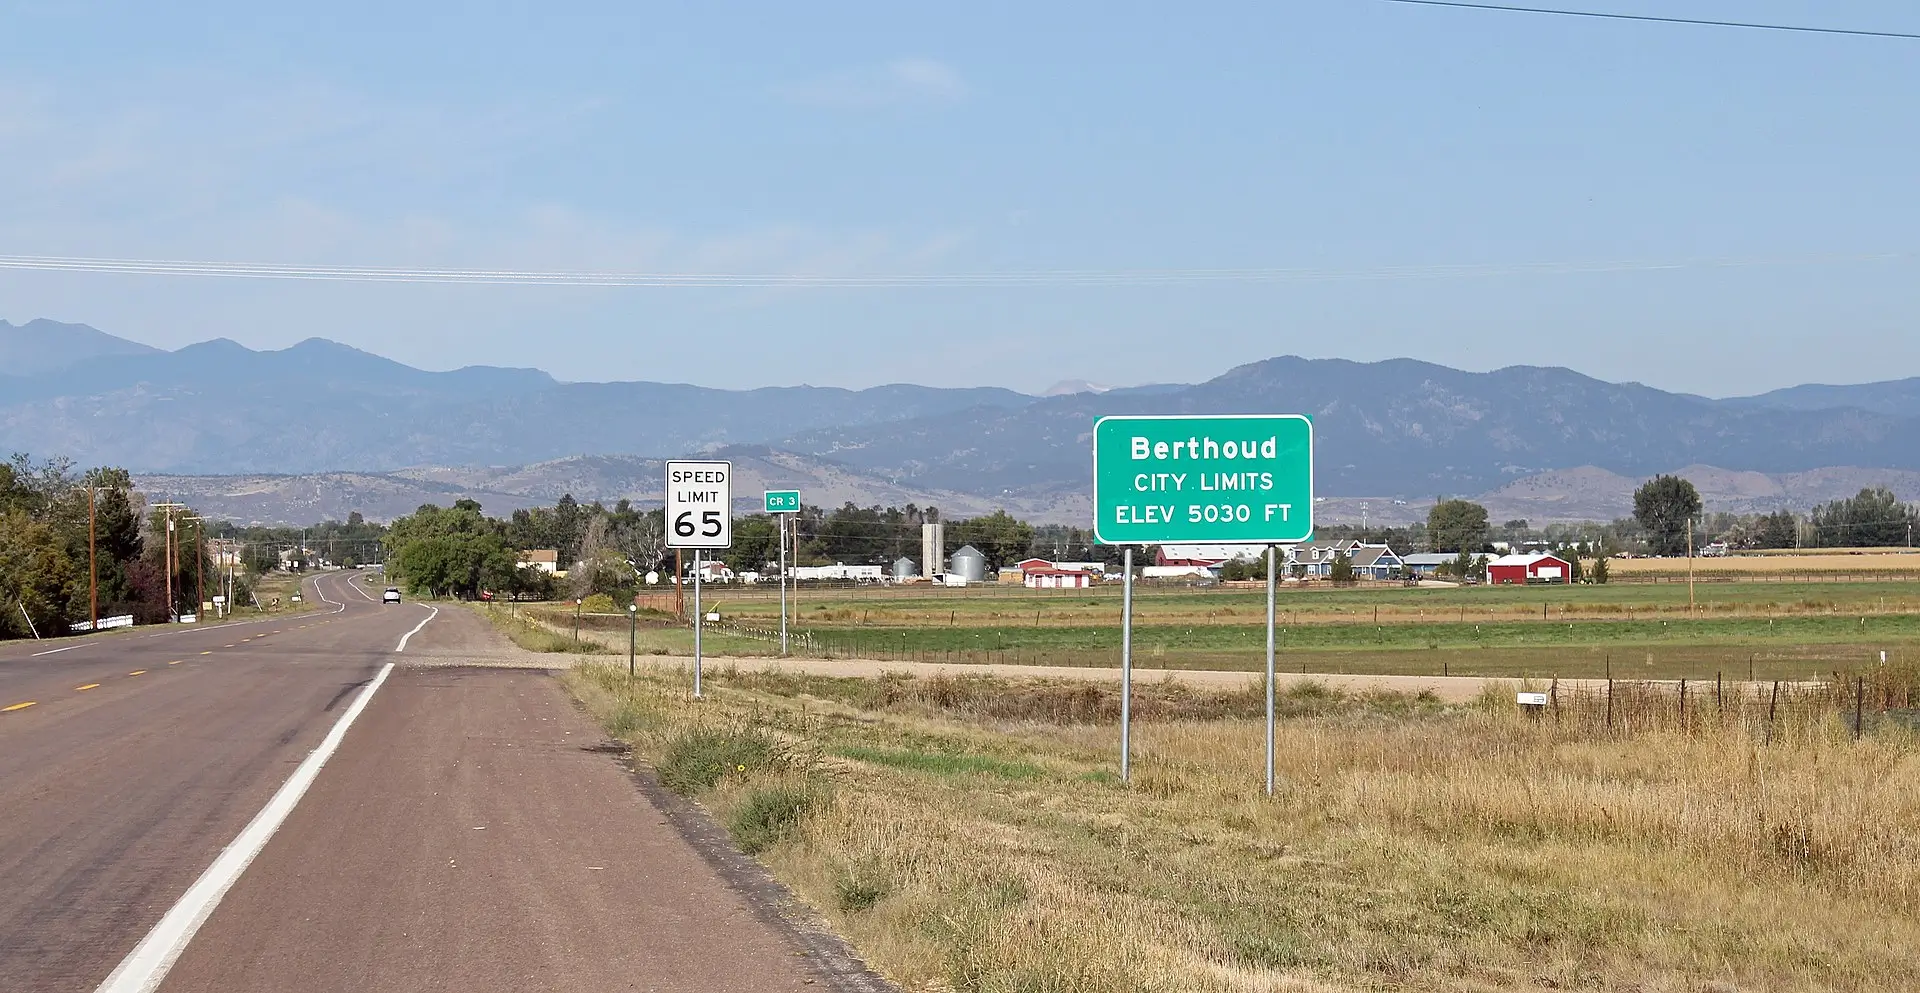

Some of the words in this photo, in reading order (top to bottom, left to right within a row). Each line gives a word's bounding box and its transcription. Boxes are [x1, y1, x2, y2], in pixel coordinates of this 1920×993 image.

[1131, 436, 1276, 460] Berthoud
[672, 471, 725, 483] SPEED
[1134, 473, 1187, 491] CITY
[1200, 472, 1274, 491] LIMITS
[678, 491, 719, 503] LIMIT
[769, 497, 784, 506] CR
[788, 497, 796, 506] 3
[1116, 505, 1175, 524] ELEV
[1188, 504, 1251, 523] 5030
[1264, 504, 1292, 522] FT
[674, 511, 722, 537] 65
